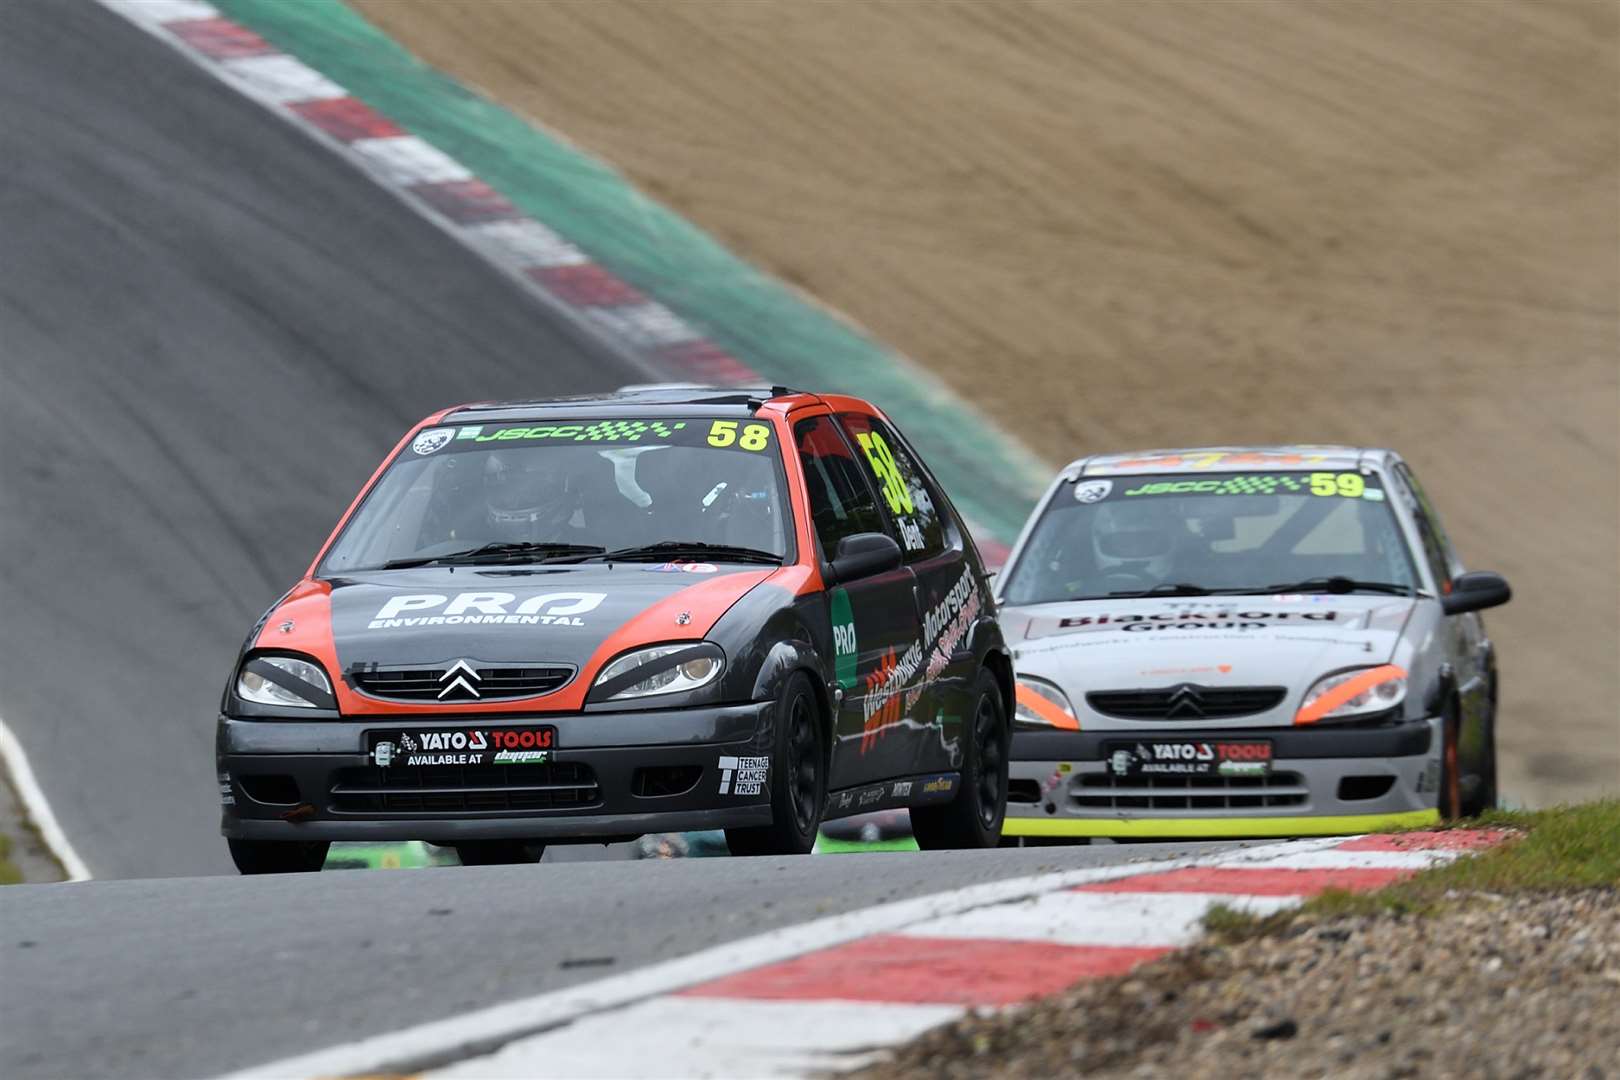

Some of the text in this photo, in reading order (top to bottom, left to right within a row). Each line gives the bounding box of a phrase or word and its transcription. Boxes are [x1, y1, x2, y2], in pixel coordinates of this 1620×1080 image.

[706, 419, 770, 451] 58
[856, 431, 914, 515] 58
[1309, 472, 1364, 498] 59
[375, 592, 608, 619] PRO
[922, 561, 979, 650] Motorsport
[367, 615, 586, 629] ENVIRONMENTAL
[1058, 611, 1337, 628] Blackford
[1121, 622, 1267, 632] Group
[833, 622, 856, 656] PRO
[419, 730, 551, 750] YATO TOOLS
[407, 753, 483, 766] AVAILABLE AT
[1152, 743, 1197, 760] YATO
[738, 770, 767, 782] CANCER
[1141, 763, 1196, 773] AVAILABLE
[736, 782, 761, 795] TRUST
